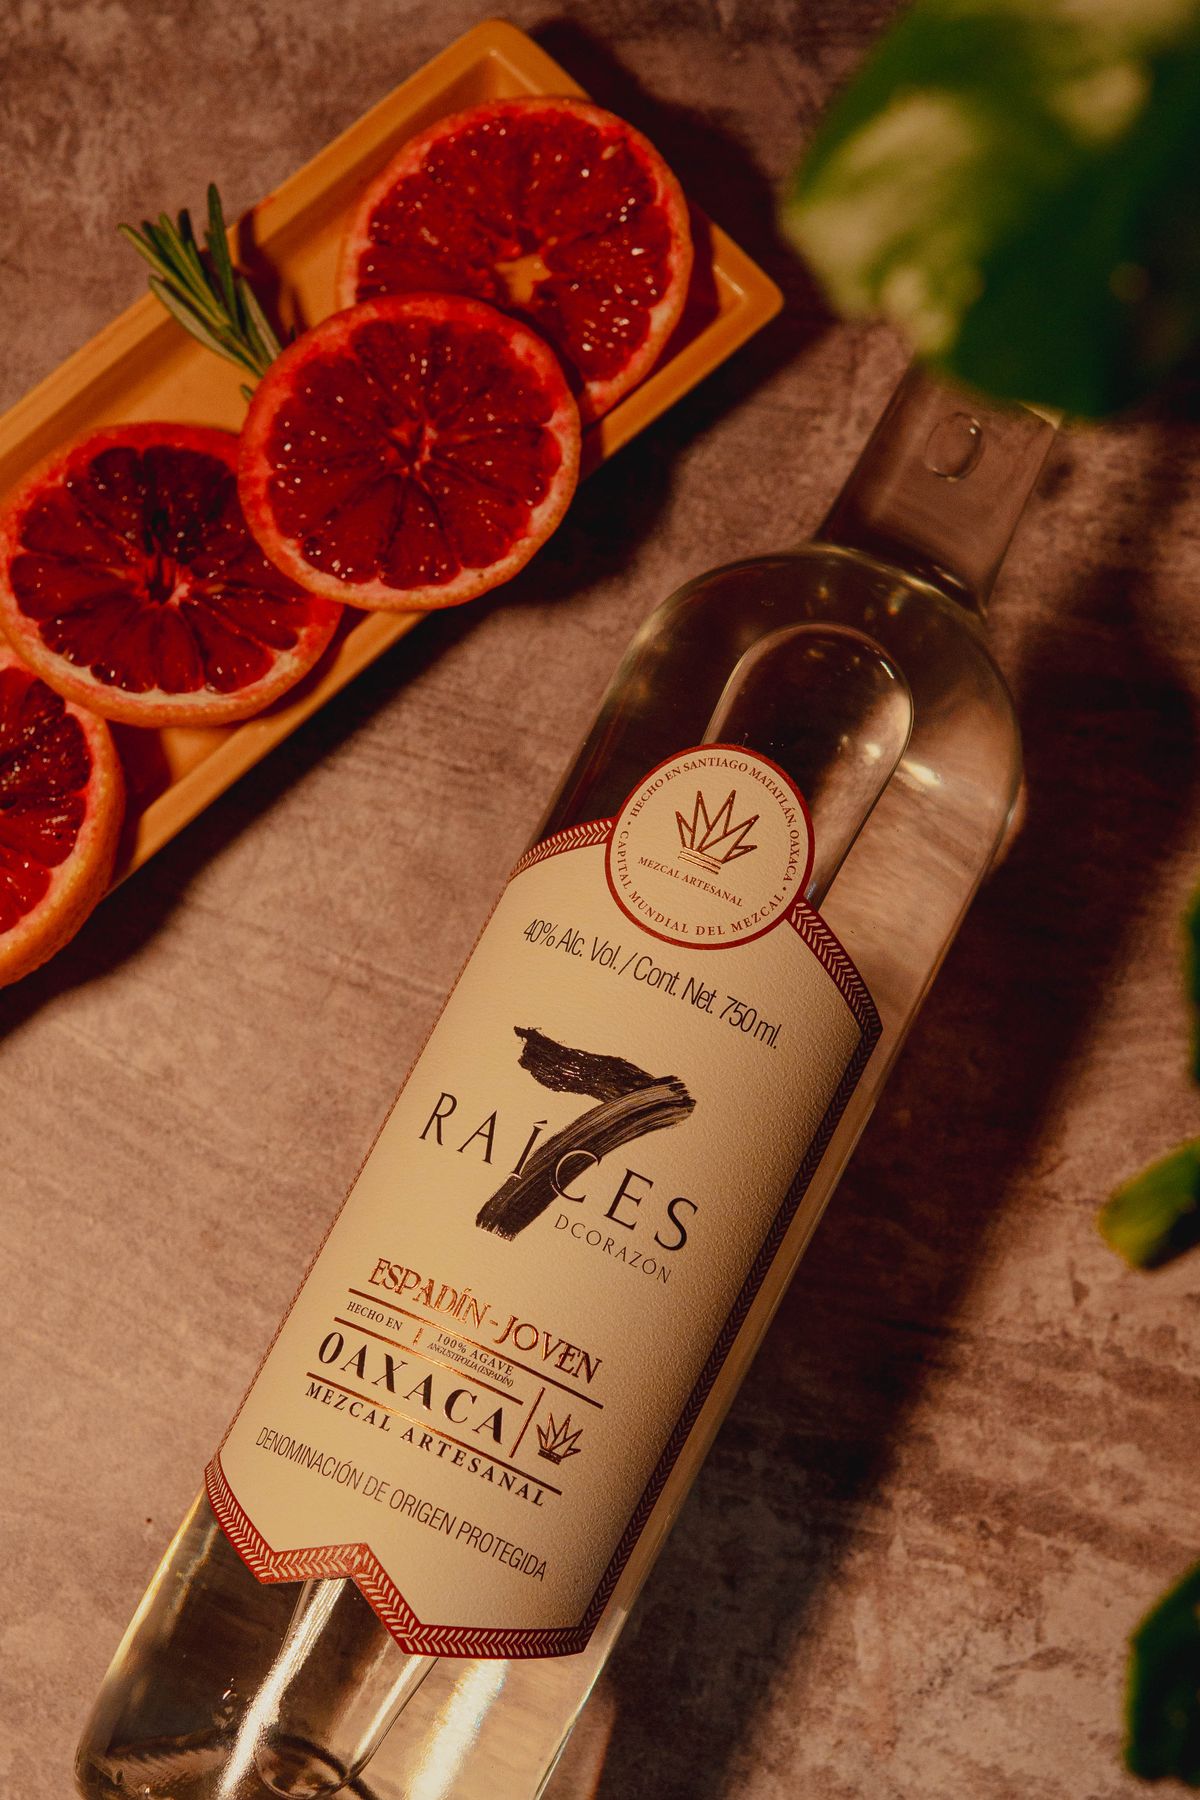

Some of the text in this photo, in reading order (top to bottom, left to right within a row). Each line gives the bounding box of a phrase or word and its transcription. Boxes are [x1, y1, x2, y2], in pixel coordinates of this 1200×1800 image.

[630, 757, 799, 883] HECHO EN SANTIAGO MATATLÁN, OAXACA
[617, 830, 784, 936] CAPITAL MUNDIAL DEL MEZCAL
[638, 856, 743, 907] MEZCAL ARTESANAL
[523, 918, 558, 947] 40%
[557, 927, 585, 957] Alc.
[590, 936, 622, 970] Vol.
[633, 956, 680, 996] Cont.
[681, 976, 717, 1015] Net.
[718, 995, 758, 1033] 750
[753, 1019, 782, 1050] ml.
[418, 1091, 699, 1251] RAÍCES
[475, 1025, 697, 1242] 7
[554, 1213, 672, 1284] DCORAZÓN
[346, 1301, 404, 1331] HECHO EN
[436, 1333, 514, 1376] 100% AGAVE
[493, 1314, 603, 1384] JOVEN
[304, 1381, 546, 1507] MEZCAL ARTESANAL
[317, 1331, 505, 1445] OAXACA
[255, 1426, 548, 1582] DENOMINACIÓN DE ORIGEN PROTEGIDA
